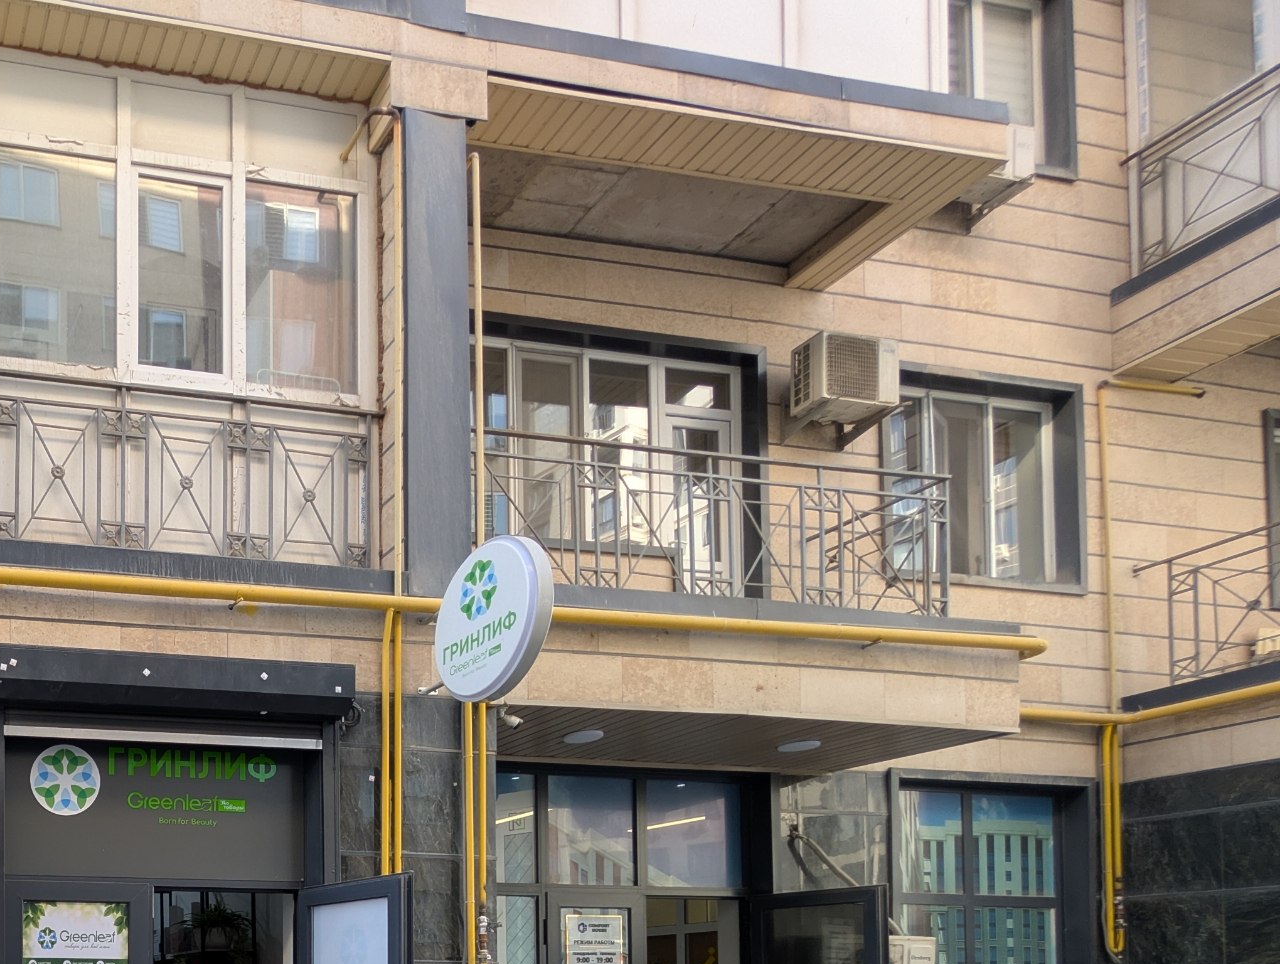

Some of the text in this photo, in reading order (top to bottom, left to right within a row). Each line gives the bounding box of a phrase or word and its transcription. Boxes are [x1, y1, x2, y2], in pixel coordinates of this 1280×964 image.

[442, 610, 517, 666] ГРИНЛИФ
[108, 746, 278, 783] ГРИНЛИФ
[127, 791, 219, 812] Greenleaf
[158, 817, 217, 827] Born for Beauty
[60, 930, 116, 943] Greenleaf
